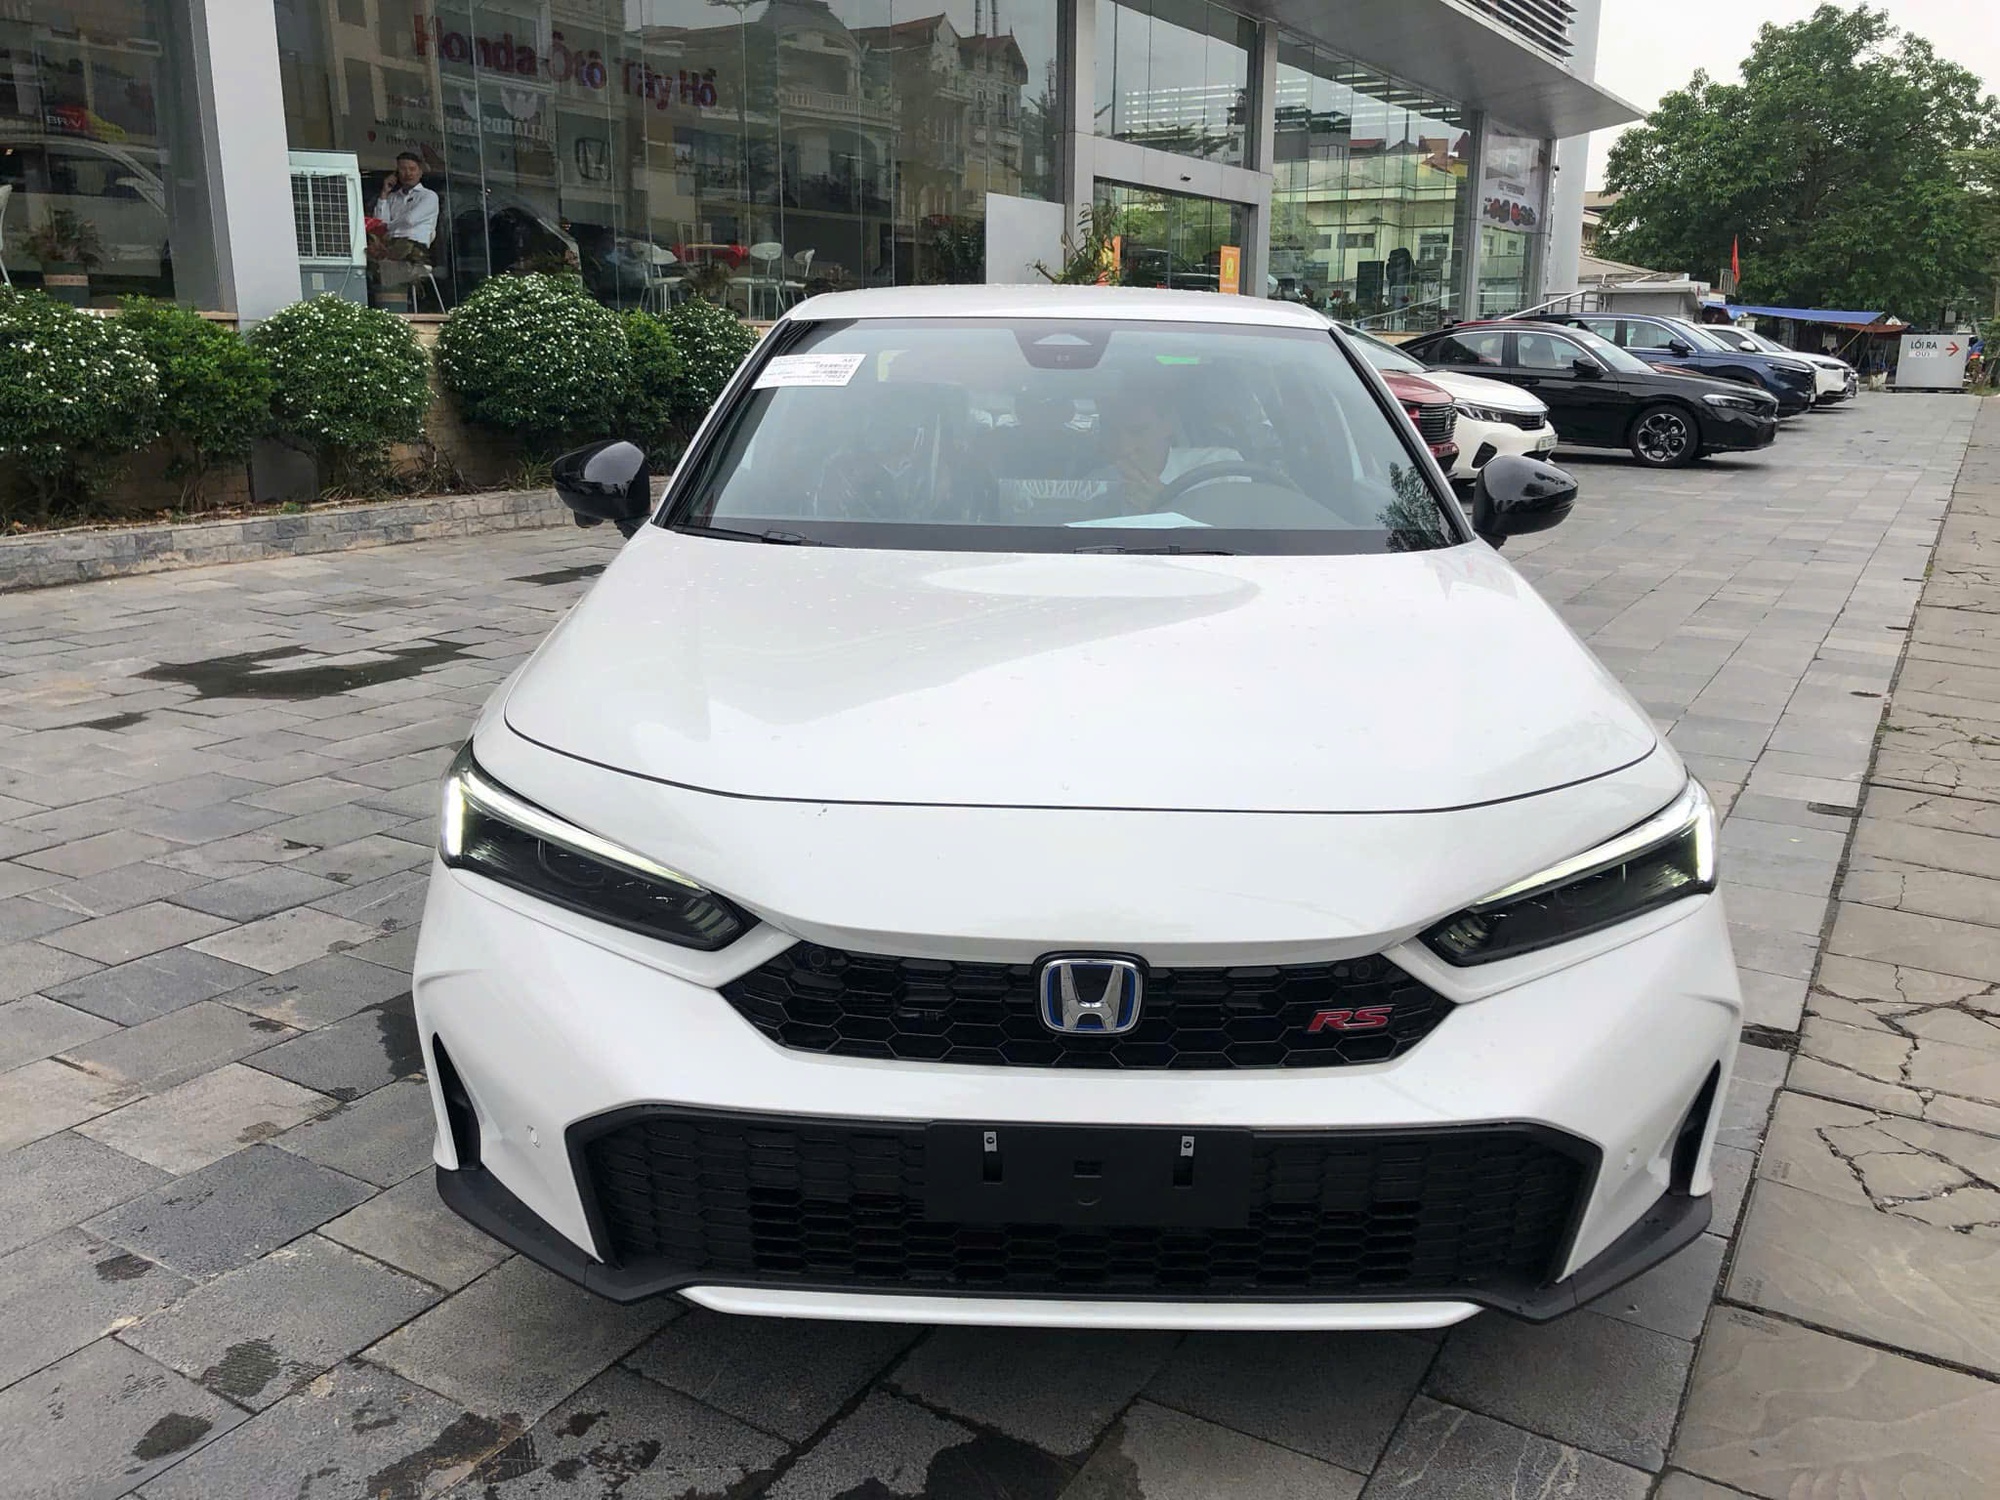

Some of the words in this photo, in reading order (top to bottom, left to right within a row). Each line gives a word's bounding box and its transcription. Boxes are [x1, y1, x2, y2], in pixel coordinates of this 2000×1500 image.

[414, 14, 538, 75] Honda
[1925, 341, 1938, 350] RA
[1307, 1005, 1394, 1032] RS
